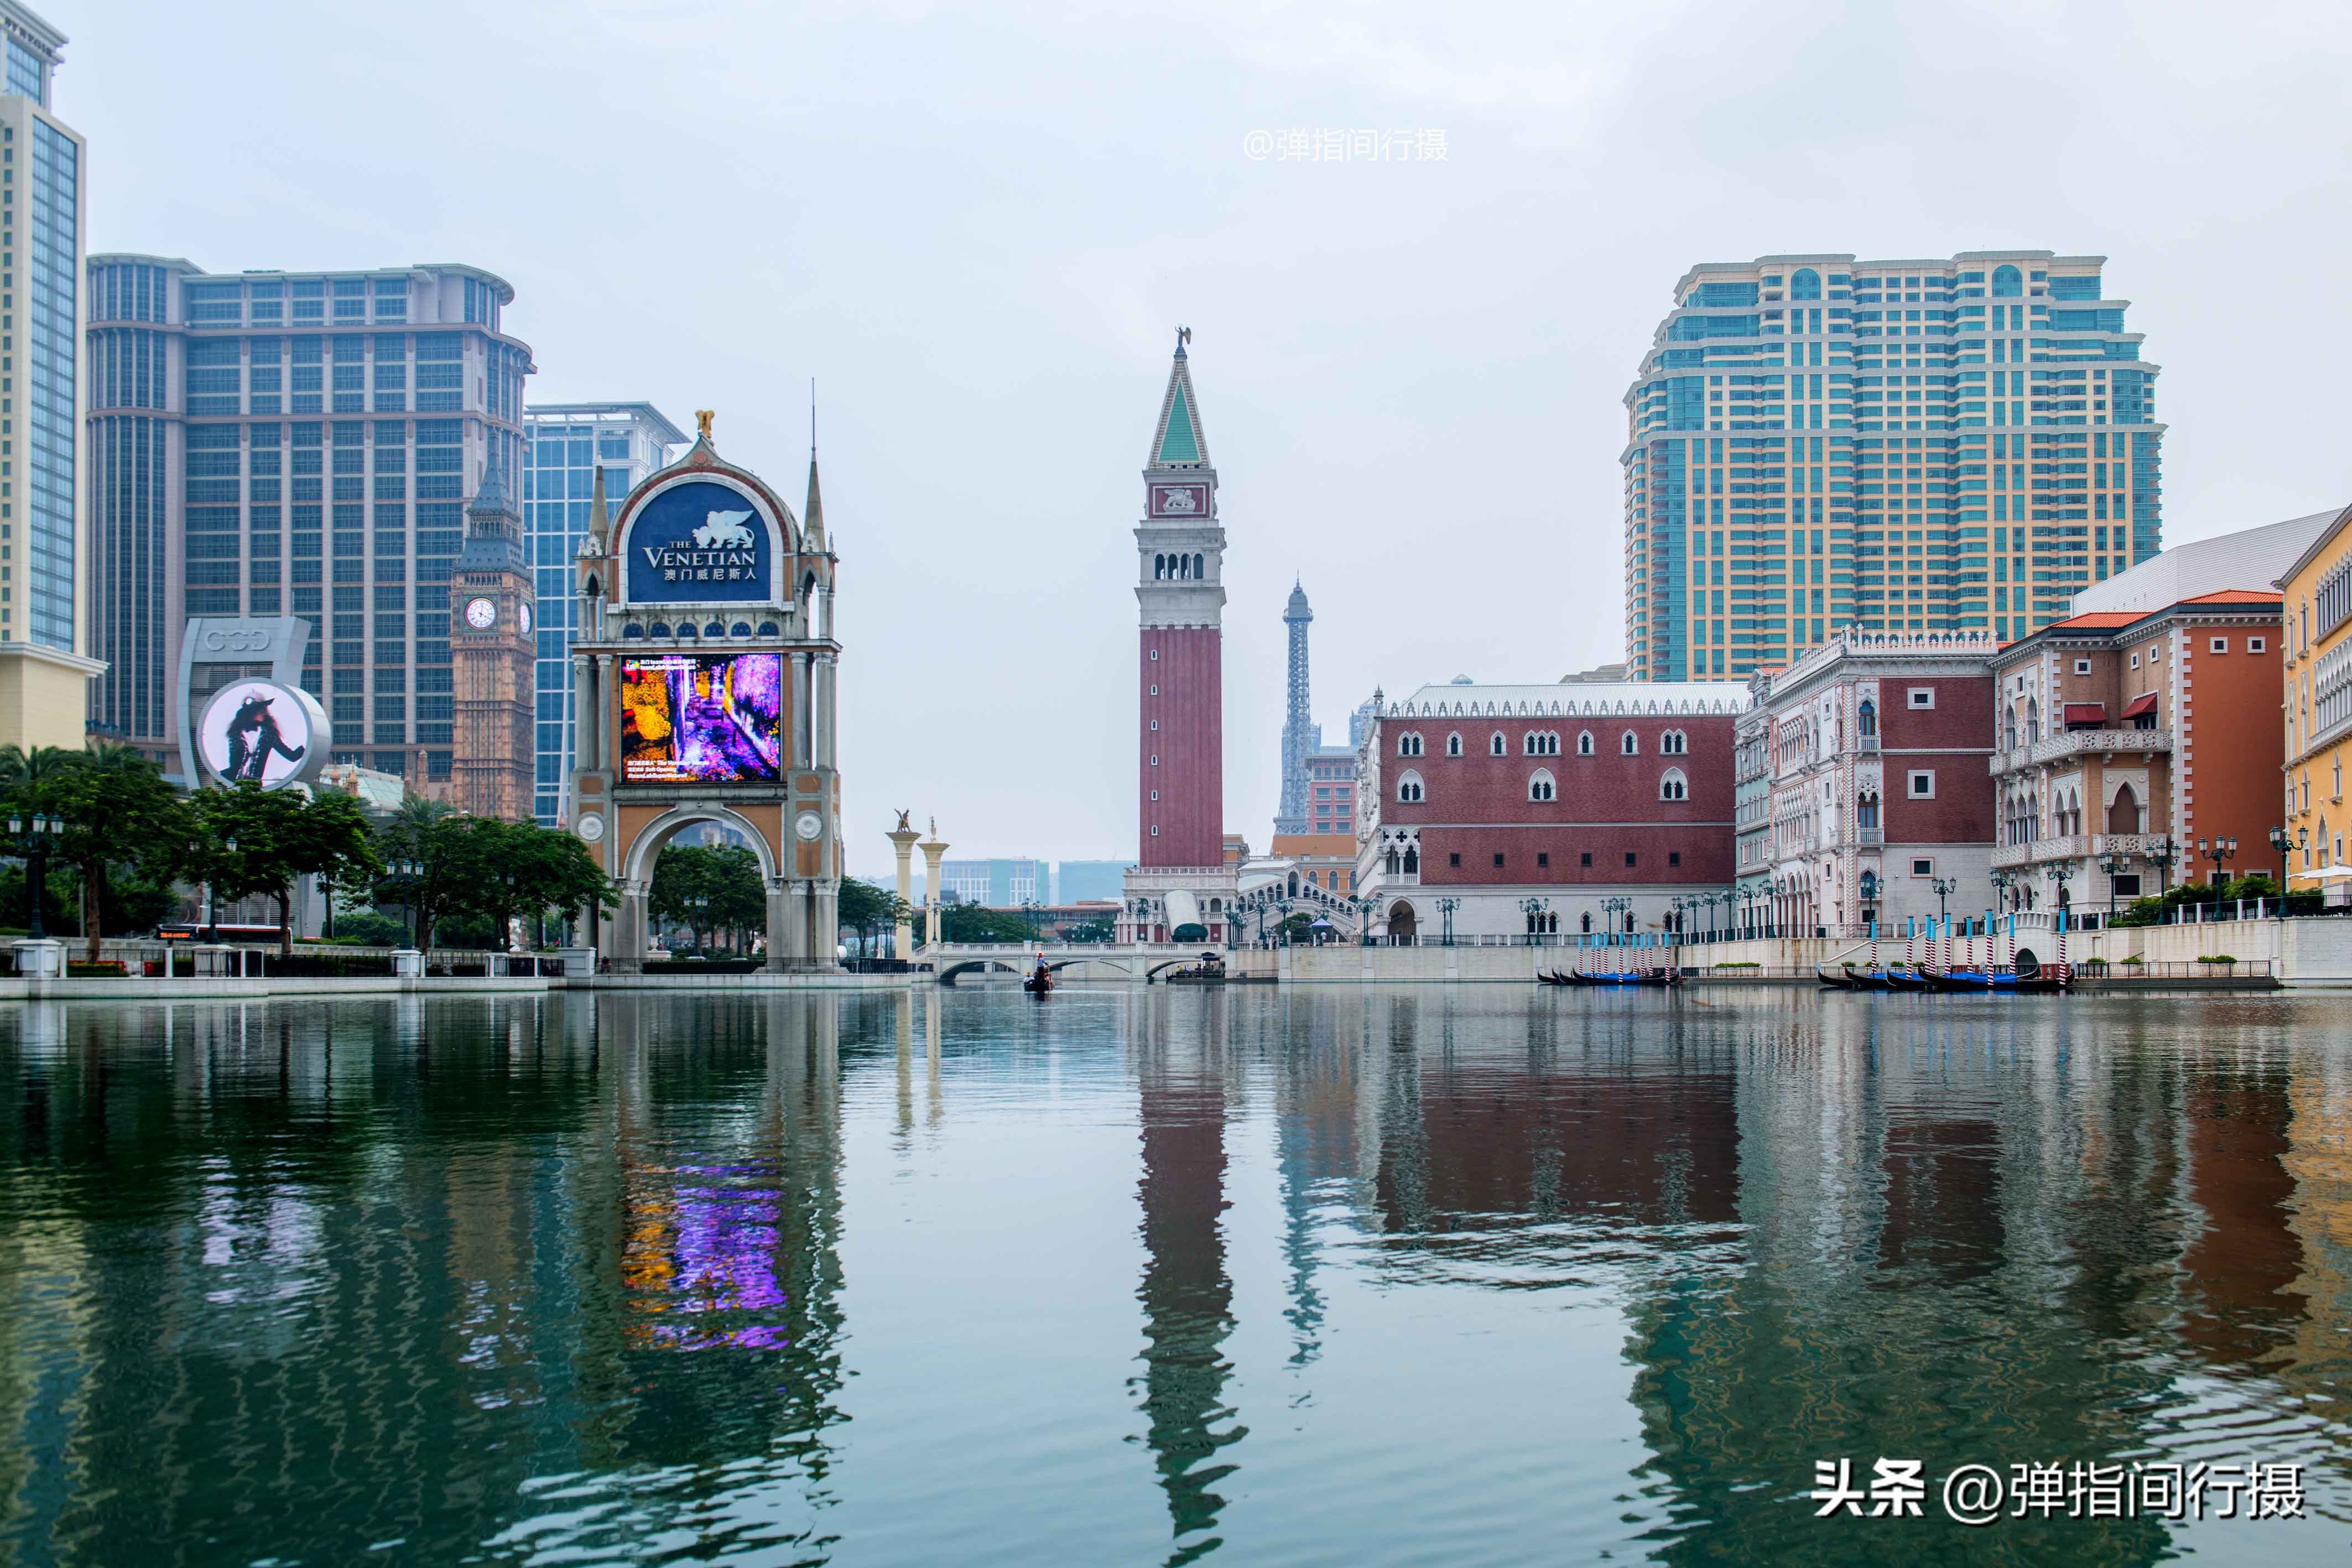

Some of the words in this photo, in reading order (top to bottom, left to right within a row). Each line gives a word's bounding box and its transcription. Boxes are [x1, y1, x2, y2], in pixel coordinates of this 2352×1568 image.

[669, 540, 691, 549] THE
[642, 547, 756, 568] VENETIAN
[664, 568, 757, 581] 澳门威尼斯人
